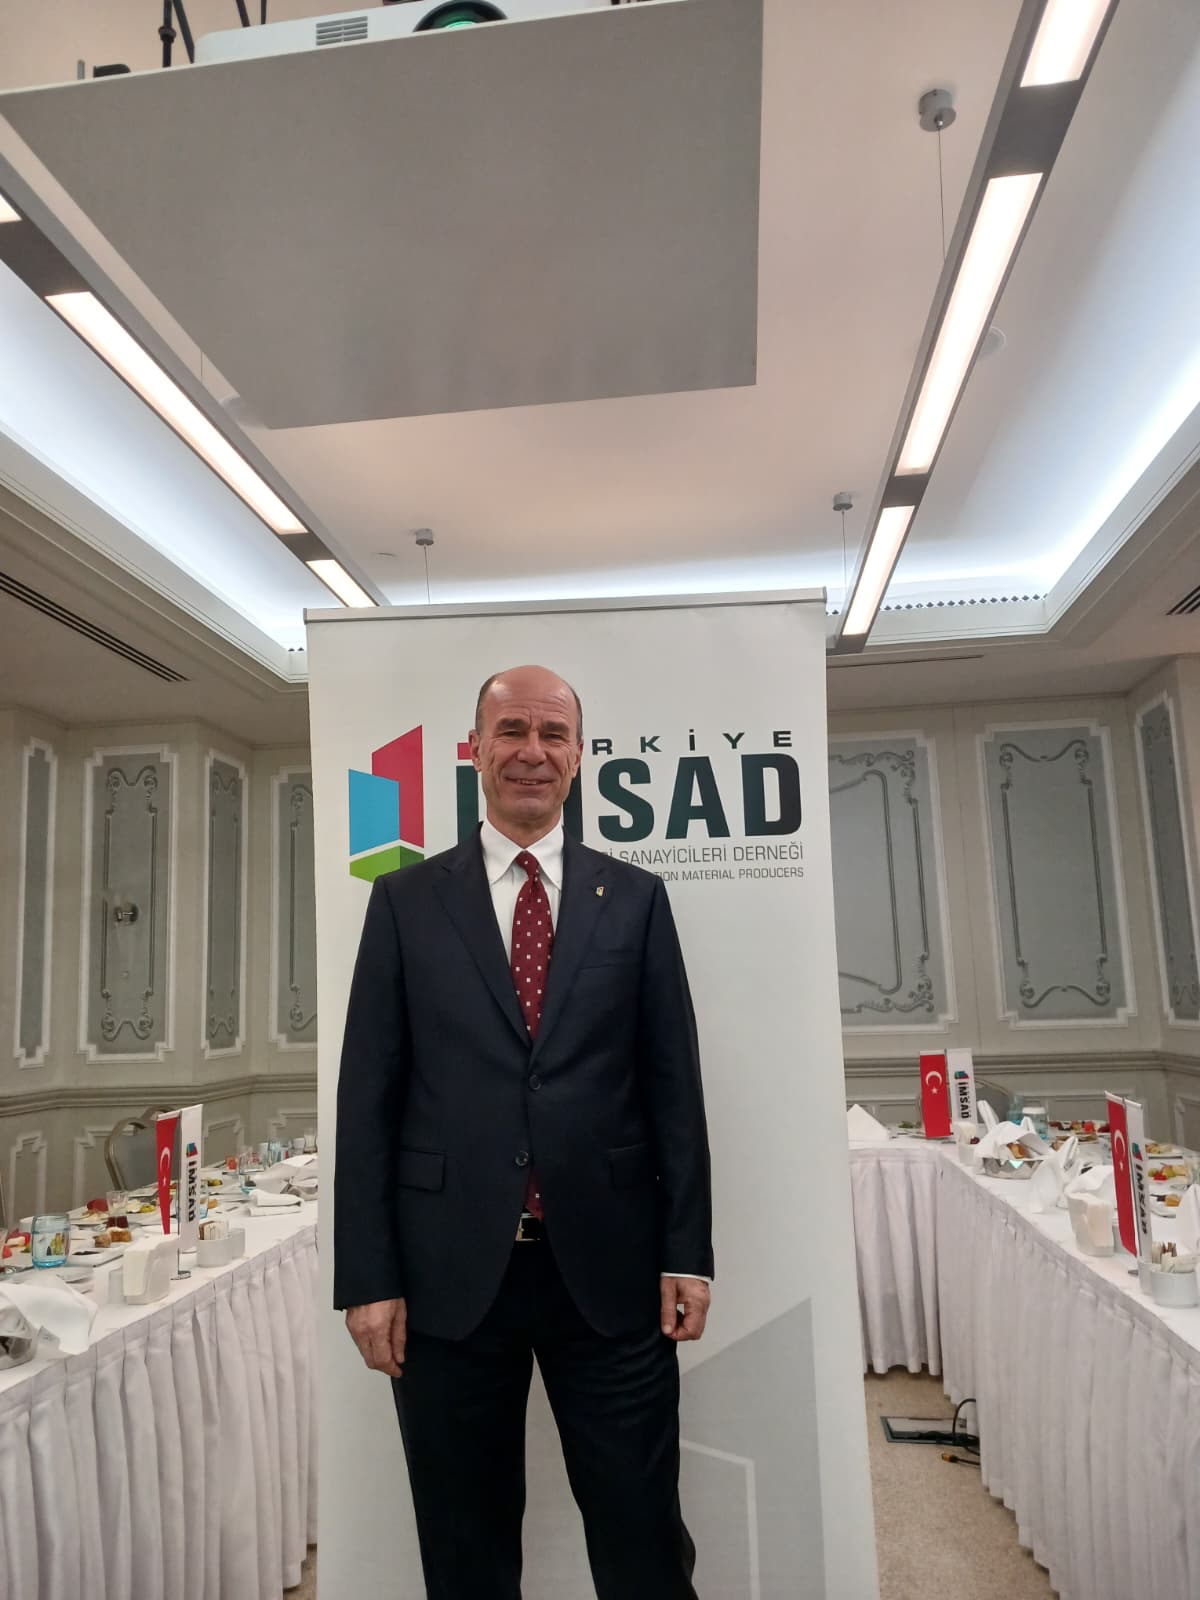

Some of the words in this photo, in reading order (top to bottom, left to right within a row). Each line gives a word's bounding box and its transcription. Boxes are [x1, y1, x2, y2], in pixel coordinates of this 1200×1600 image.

[592, 729, 792, 756] RKİYE
[733, 841, 804, 862] DERNEĞİ
[682, 869, 735, 881] MATERIAL
[738, 867, 804, 880] PRODUCERS
